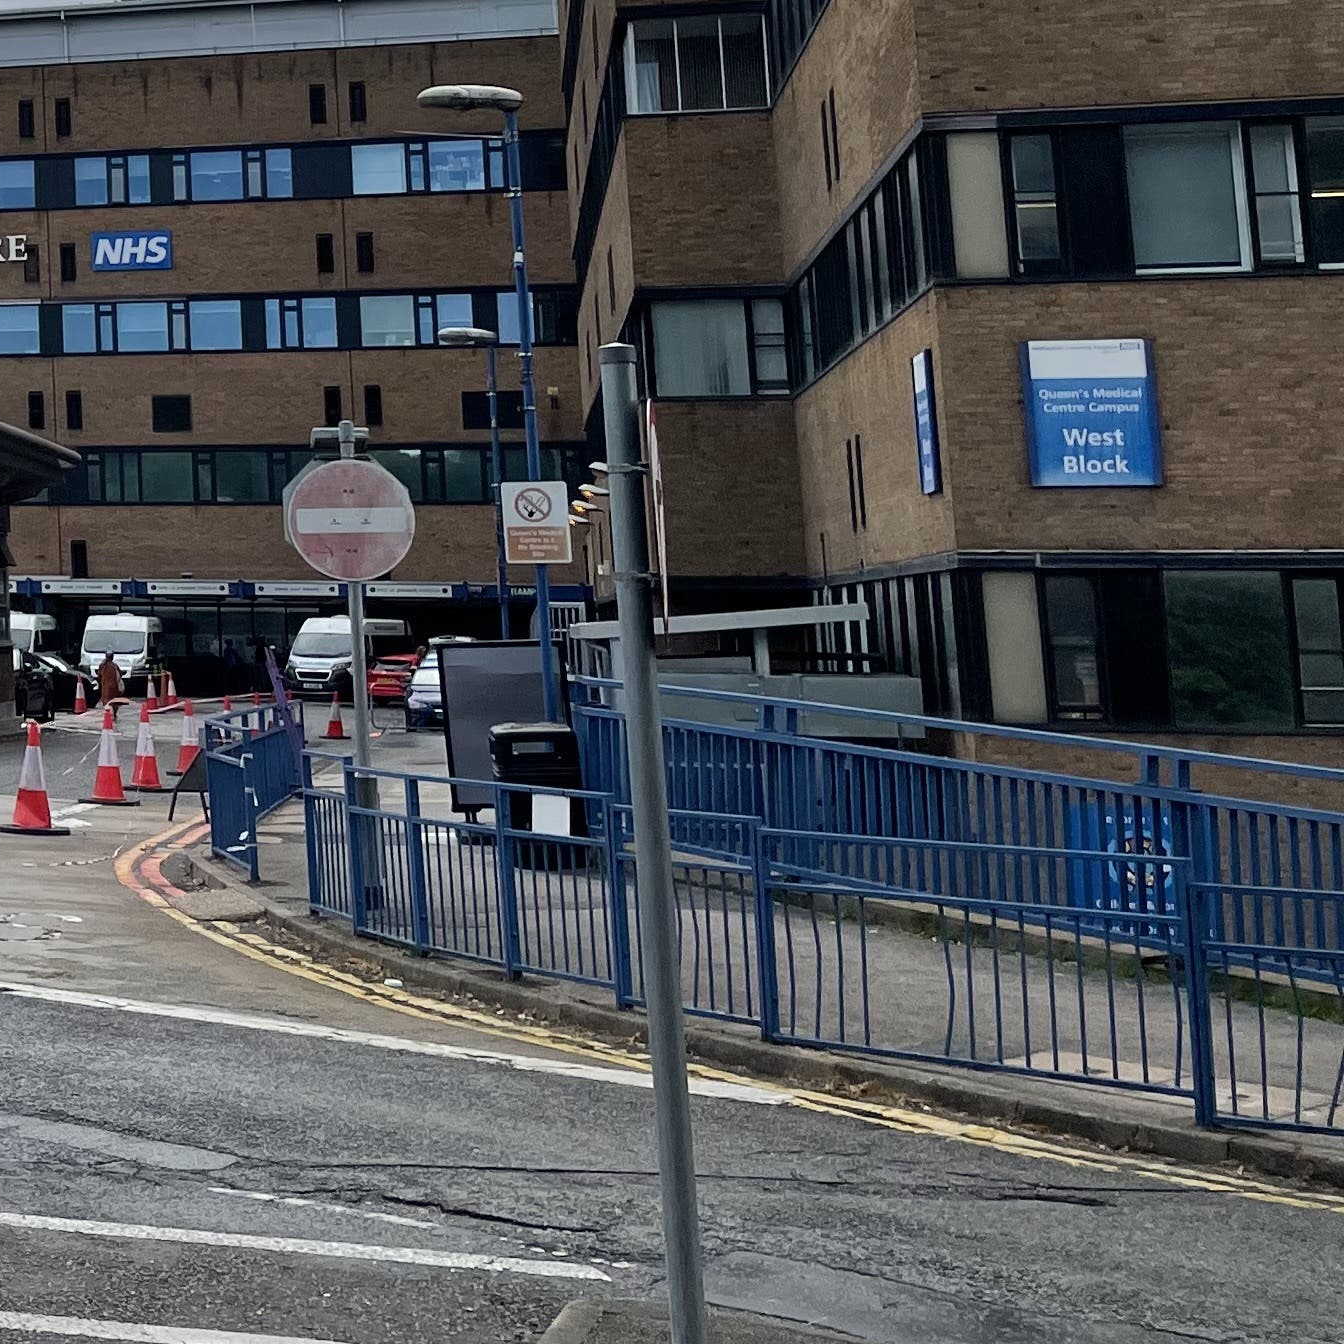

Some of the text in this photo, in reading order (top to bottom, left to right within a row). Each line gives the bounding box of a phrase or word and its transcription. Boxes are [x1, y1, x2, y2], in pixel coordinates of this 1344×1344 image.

[94, 236, 169, 265] NHS
[1038, 387, 1143, 400] Queen's Medical
[1043, 402, 1140, 414] Centre Campus
[1061, 428, 1125, 447] West
[1062, 454, 1130, 474] Block
